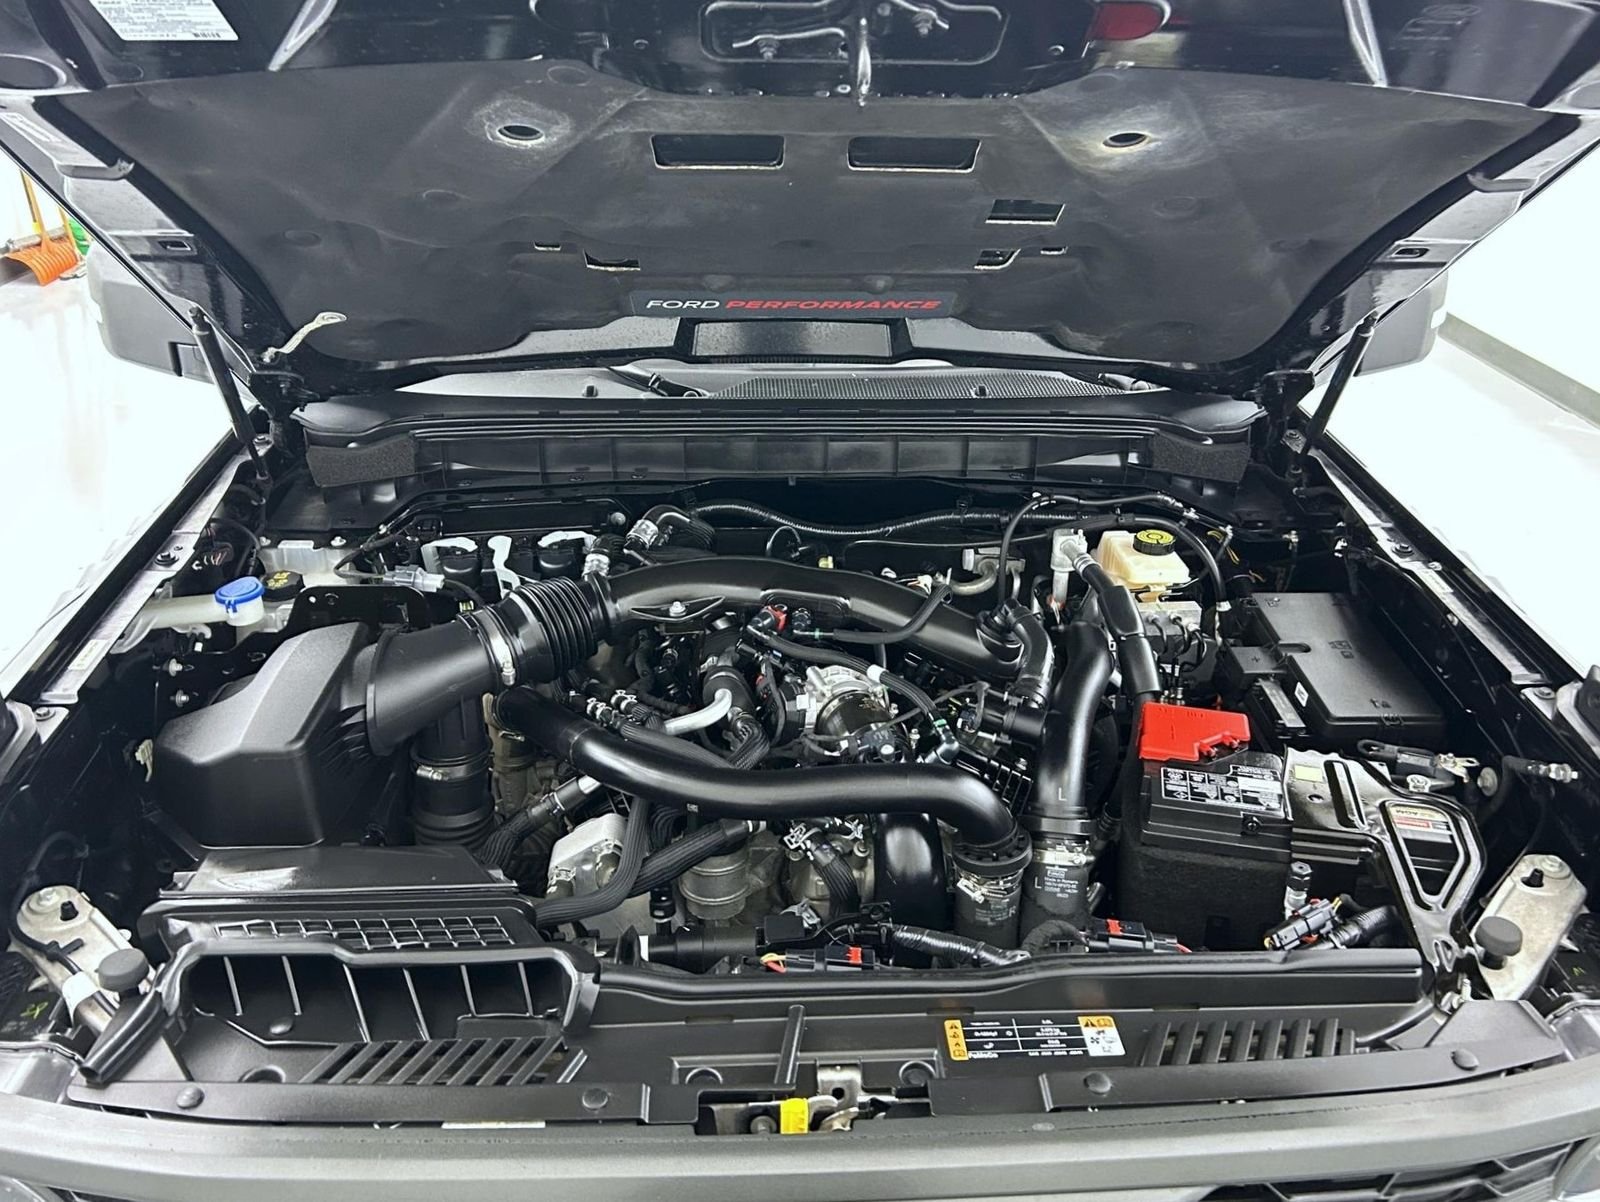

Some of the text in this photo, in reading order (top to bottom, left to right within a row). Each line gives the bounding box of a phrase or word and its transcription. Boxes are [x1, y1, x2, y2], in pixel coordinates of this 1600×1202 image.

[646, 299, 942, 310] FORD PERFORMANCE
[1058, 787, 1067, 801] L
